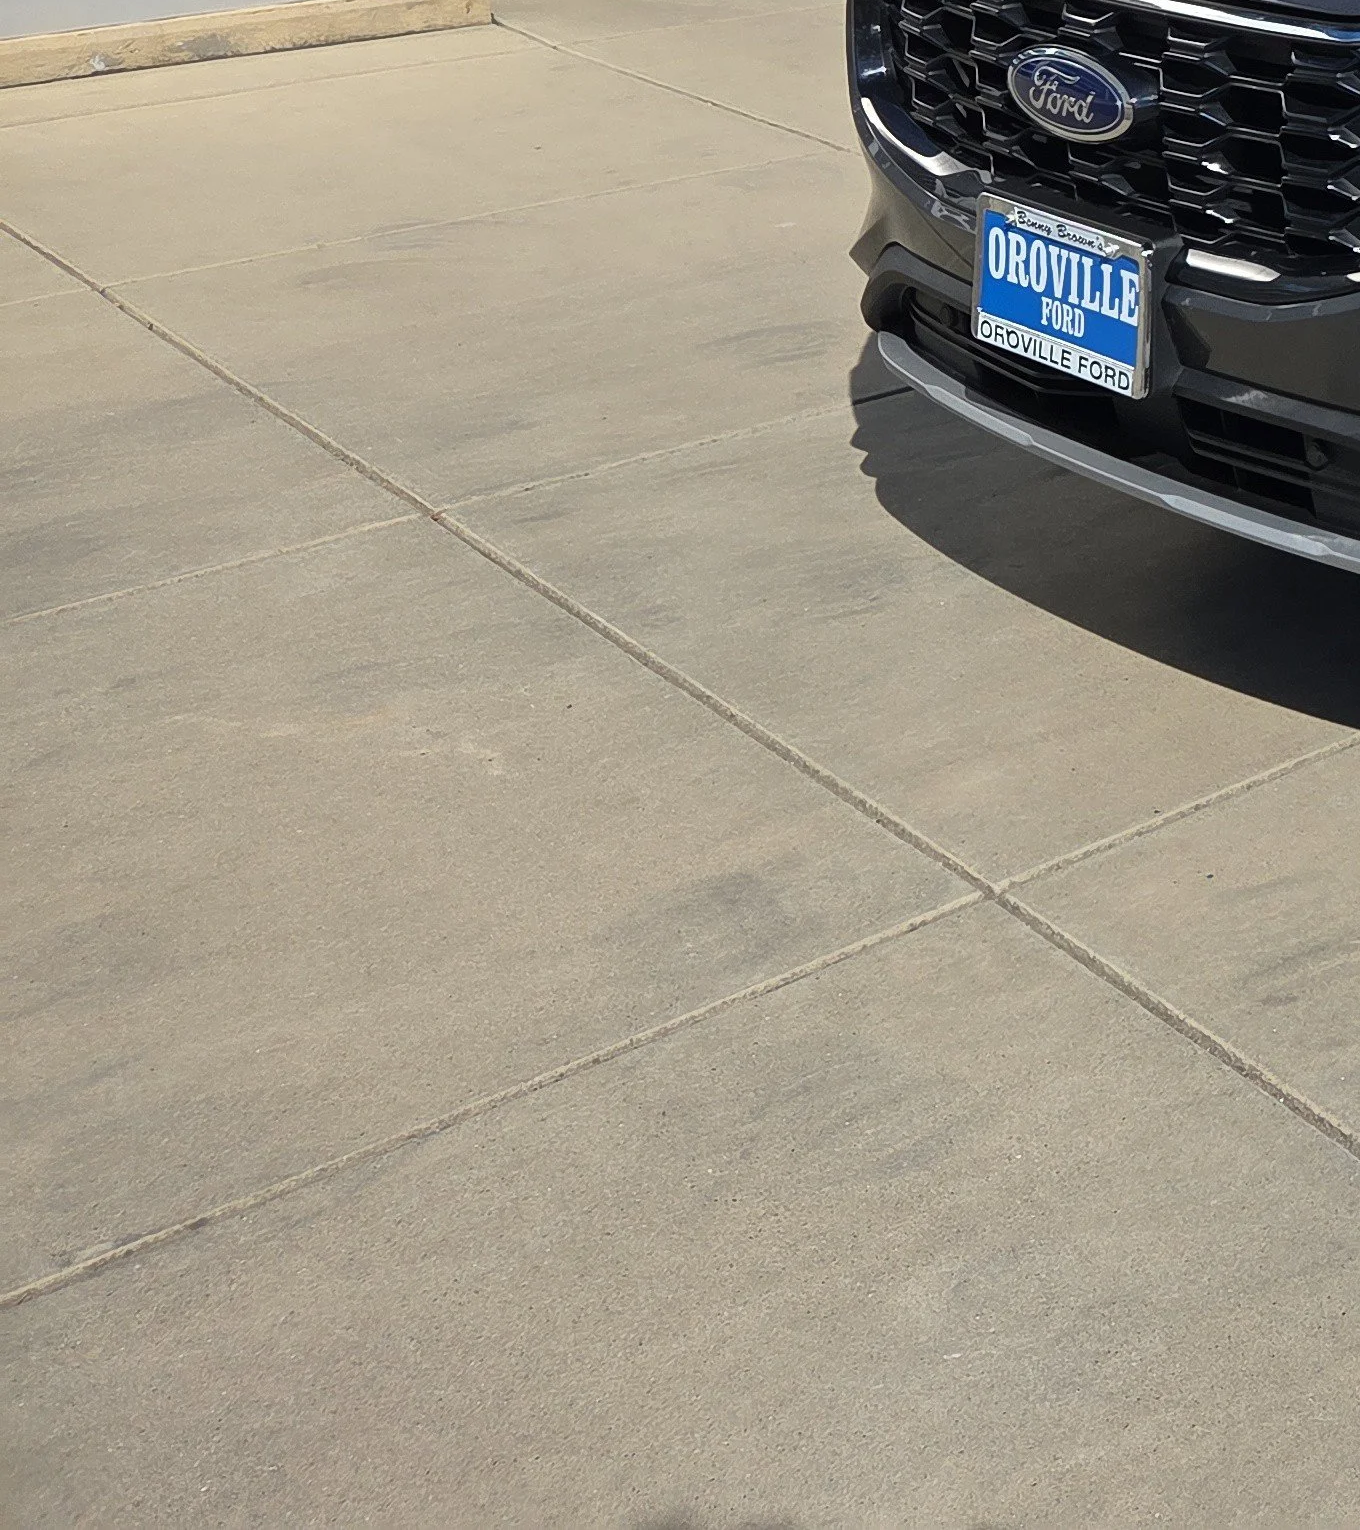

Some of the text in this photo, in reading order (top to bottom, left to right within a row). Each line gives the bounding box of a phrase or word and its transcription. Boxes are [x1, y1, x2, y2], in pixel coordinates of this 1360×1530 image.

[1028, 65, 1095, 124] Ford
[1015, 210, 1104, 252] Benny Brown's
[988, 226, 1140, 327] OROVILLE
[1040, 296, 1085, 338] FORD
[979, 319, 1131, 391] OROVILLE FORD
